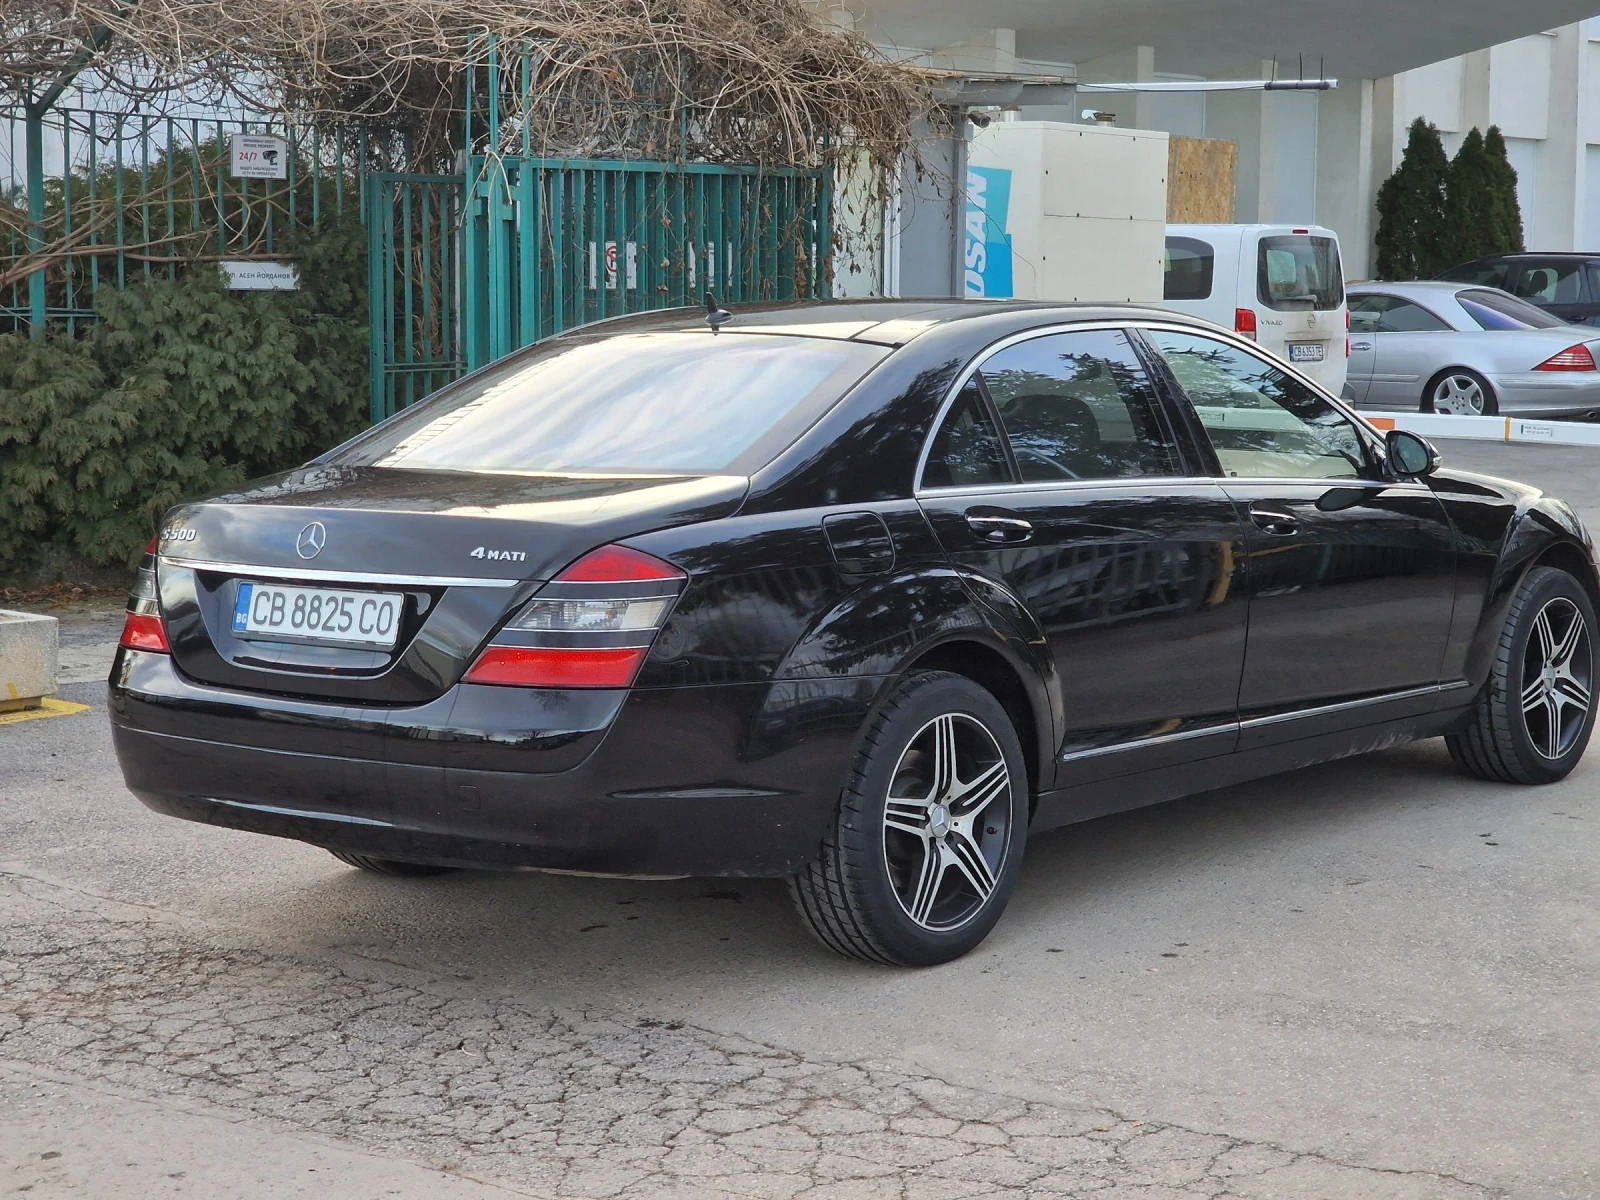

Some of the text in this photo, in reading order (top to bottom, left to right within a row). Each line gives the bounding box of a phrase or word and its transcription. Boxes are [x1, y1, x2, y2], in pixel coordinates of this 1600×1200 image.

[239, 151, 258, 162] 24/7
[256, 271, 291, 280] ЙОРДАНОВ
[1294, 346, 1302, 357] CB
[1302, 346, 1315, 357] 6353
[160, 528, 196, 541] S500
[235, 590, 394, 636] BG CB 8825 CO
